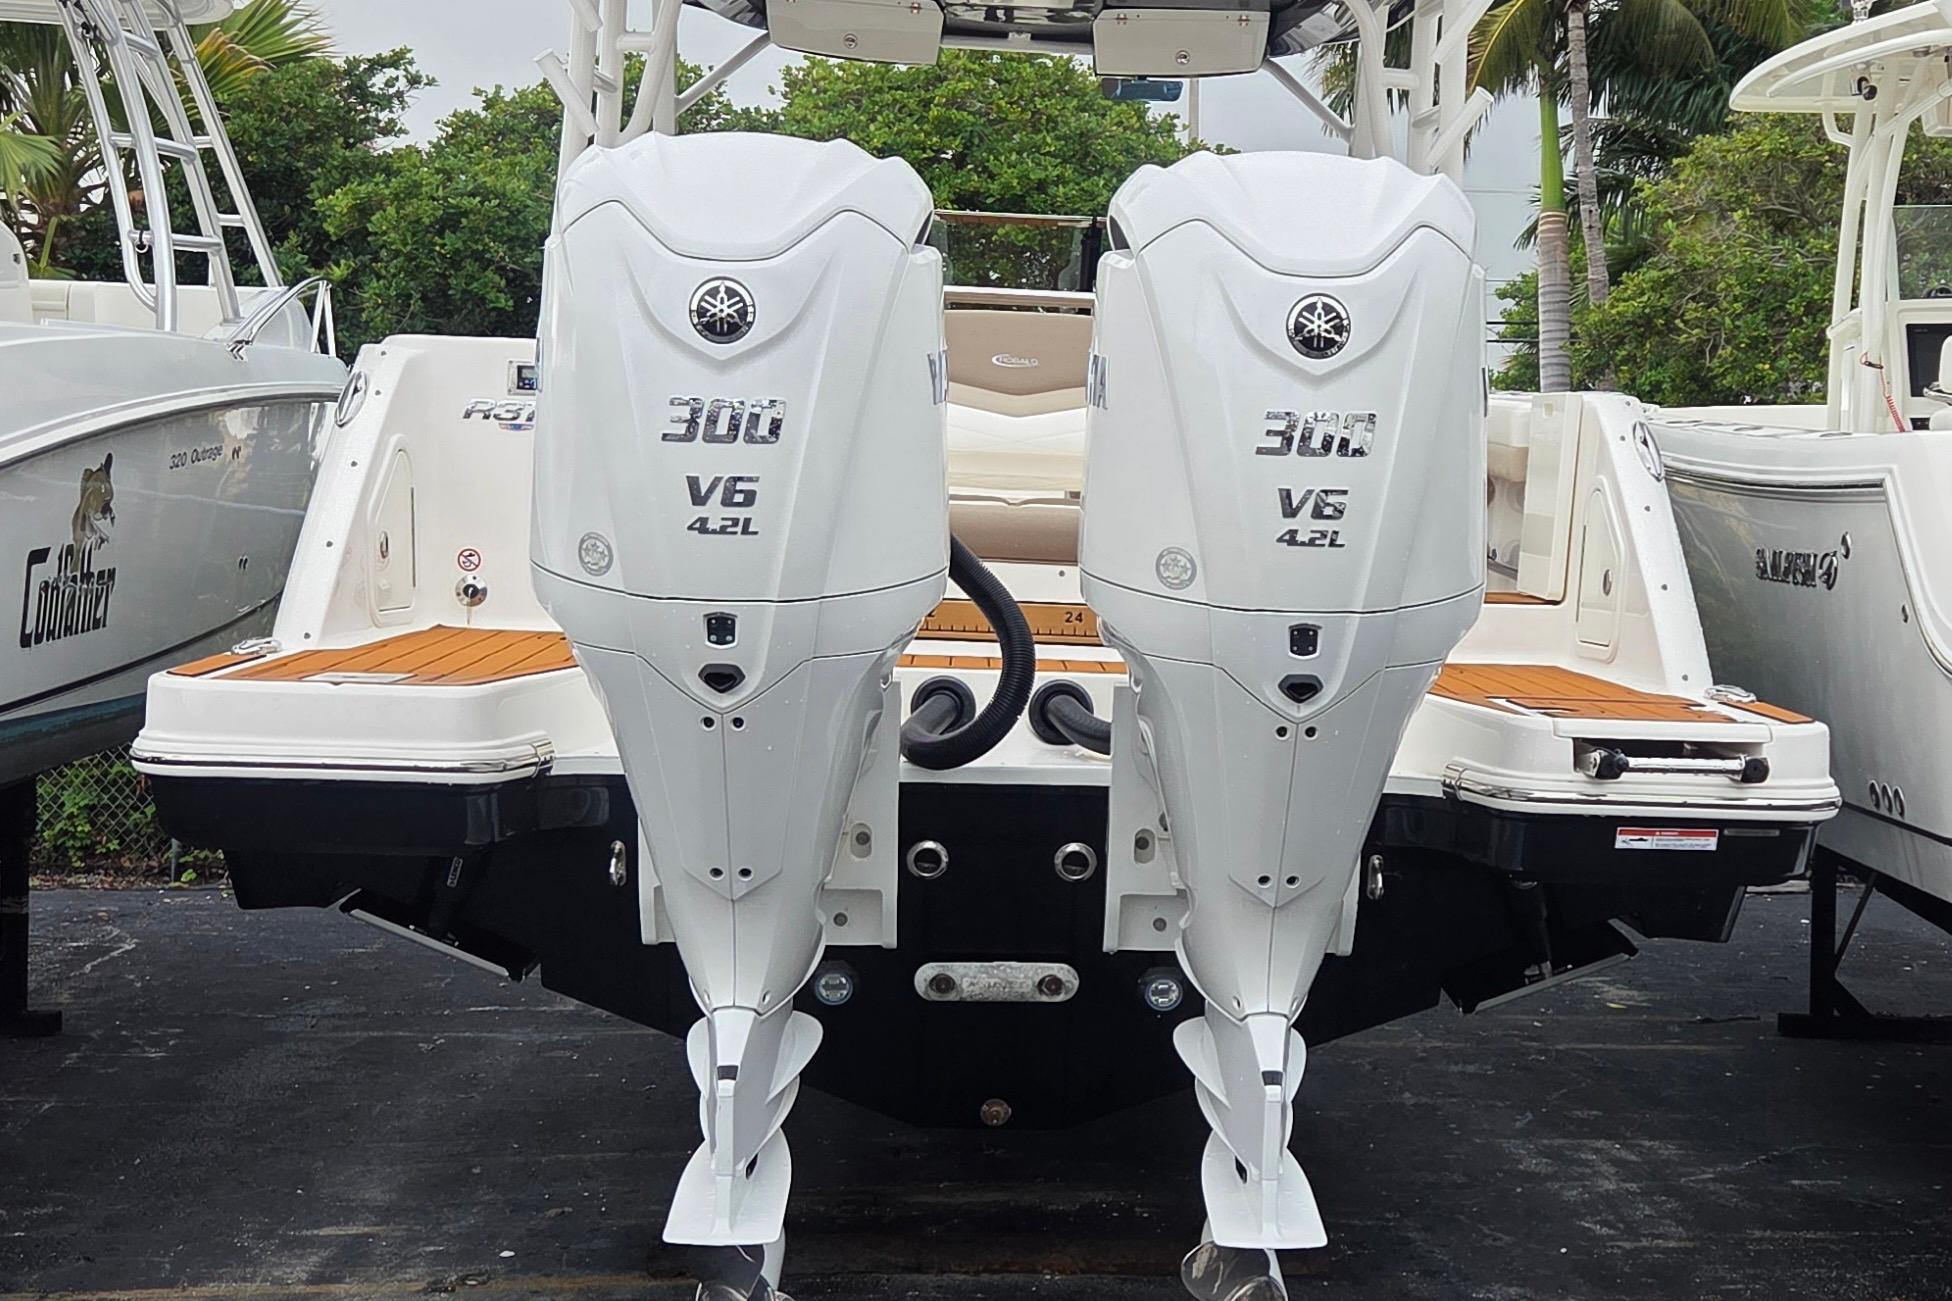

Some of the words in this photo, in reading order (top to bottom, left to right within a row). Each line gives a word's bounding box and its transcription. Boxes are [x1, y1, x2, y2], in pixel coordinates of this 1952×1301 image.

[661, 398, 787, 444] 300
[1255, 411, 1377, 457] 300
[169, 451, 188, 469] 320
[191, 445, 223, 464] Outrage
[685, 475, 760, 508] V6
[1277, 487, 1349, 520] V6
[686, 516, 760, 535] 4.2L
[1275, 529, 1346, 548] 4.2L
[1064, 612, 1084, 623] 24
